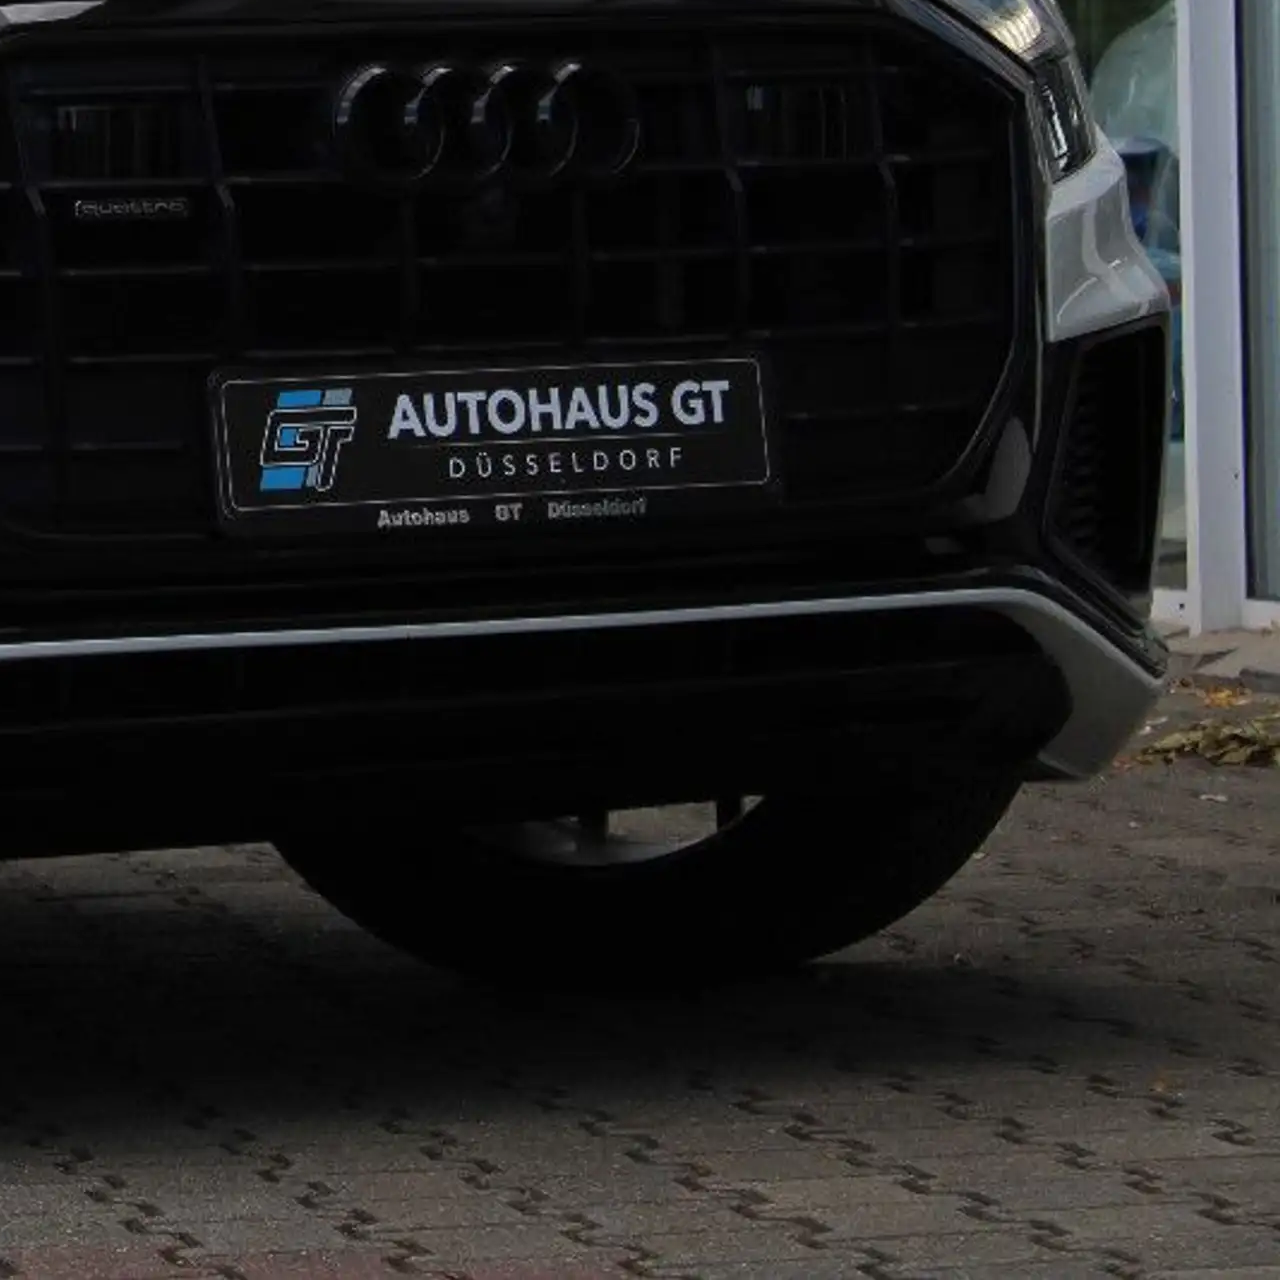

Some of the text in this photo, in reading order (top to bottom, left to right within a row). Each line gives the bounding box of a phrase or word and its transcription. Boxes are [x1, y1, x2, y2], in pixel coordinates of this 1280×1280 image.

[387, 380, 730, 439] AUTOHAUS GT
[449, 447, 683, 478] DÜSSELDORF
[377, 495, 647, 529] Autohaus GT Düsseldorf
